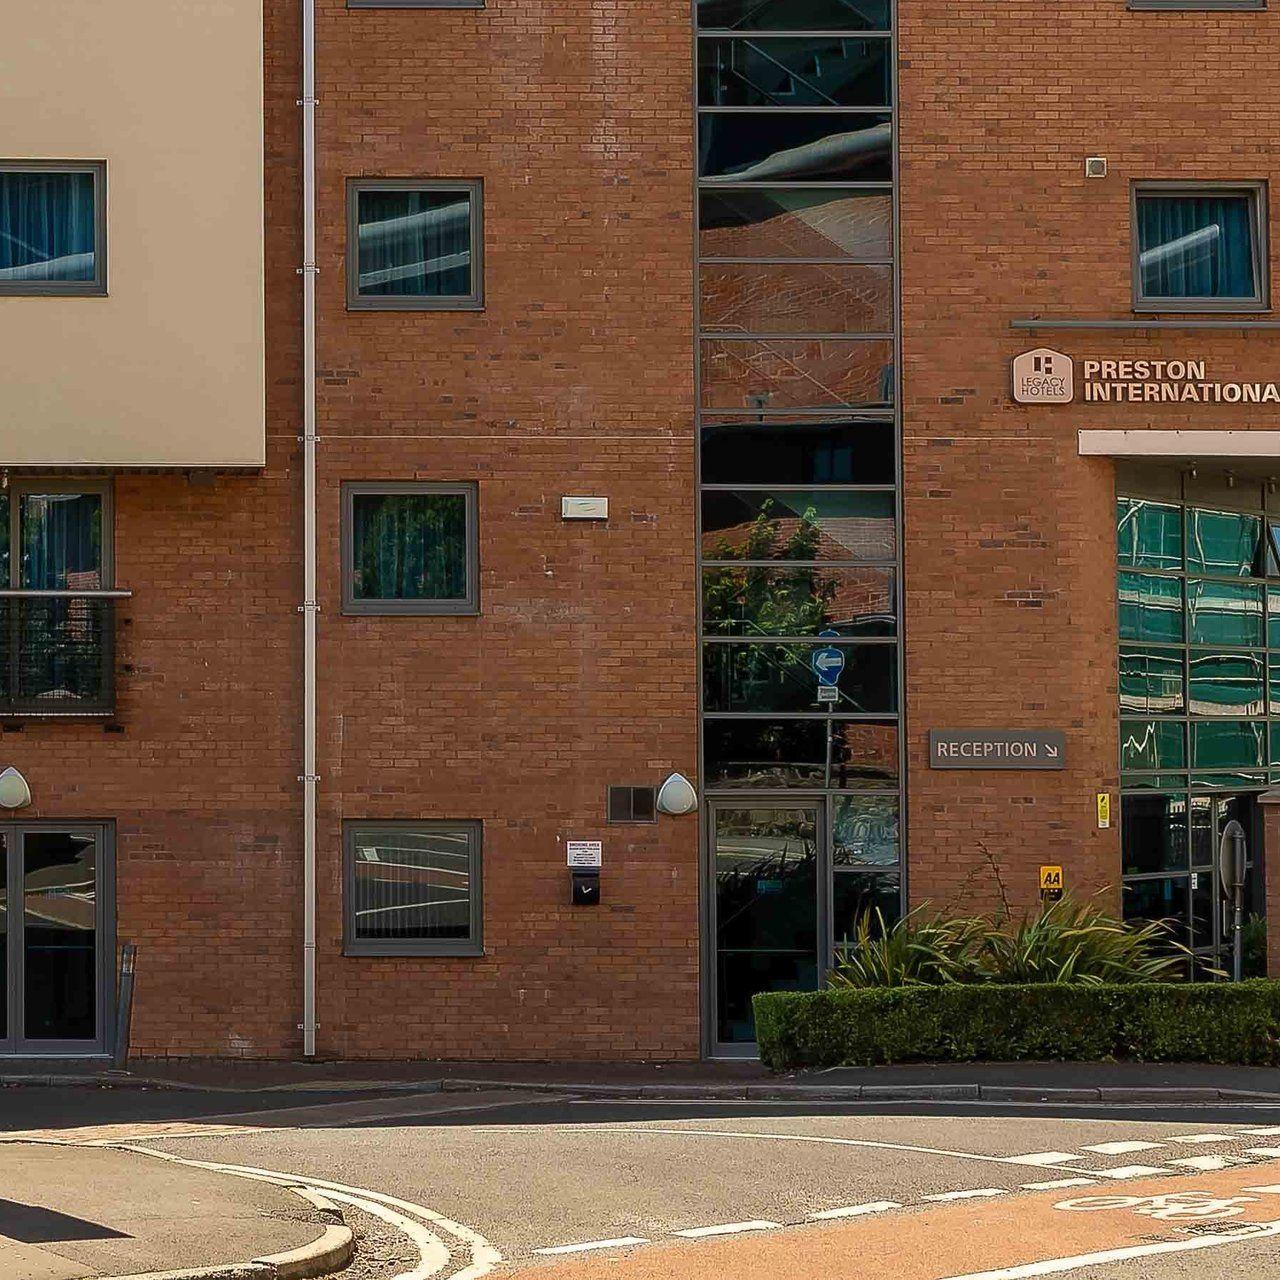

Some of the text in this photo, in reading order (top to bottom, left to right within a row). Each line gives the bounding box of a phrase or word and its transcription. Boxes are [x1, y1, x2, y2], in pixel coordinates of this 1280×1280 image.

[1084, 360, 1205, 380] PRESTON
[1021, 377, 1065, 387] LEGACY
[1021, 387, 1065, 396] HOTELS
[937, 742, 1037, 757] RECEPTION
[1043, 871, 1060, 885] AA
